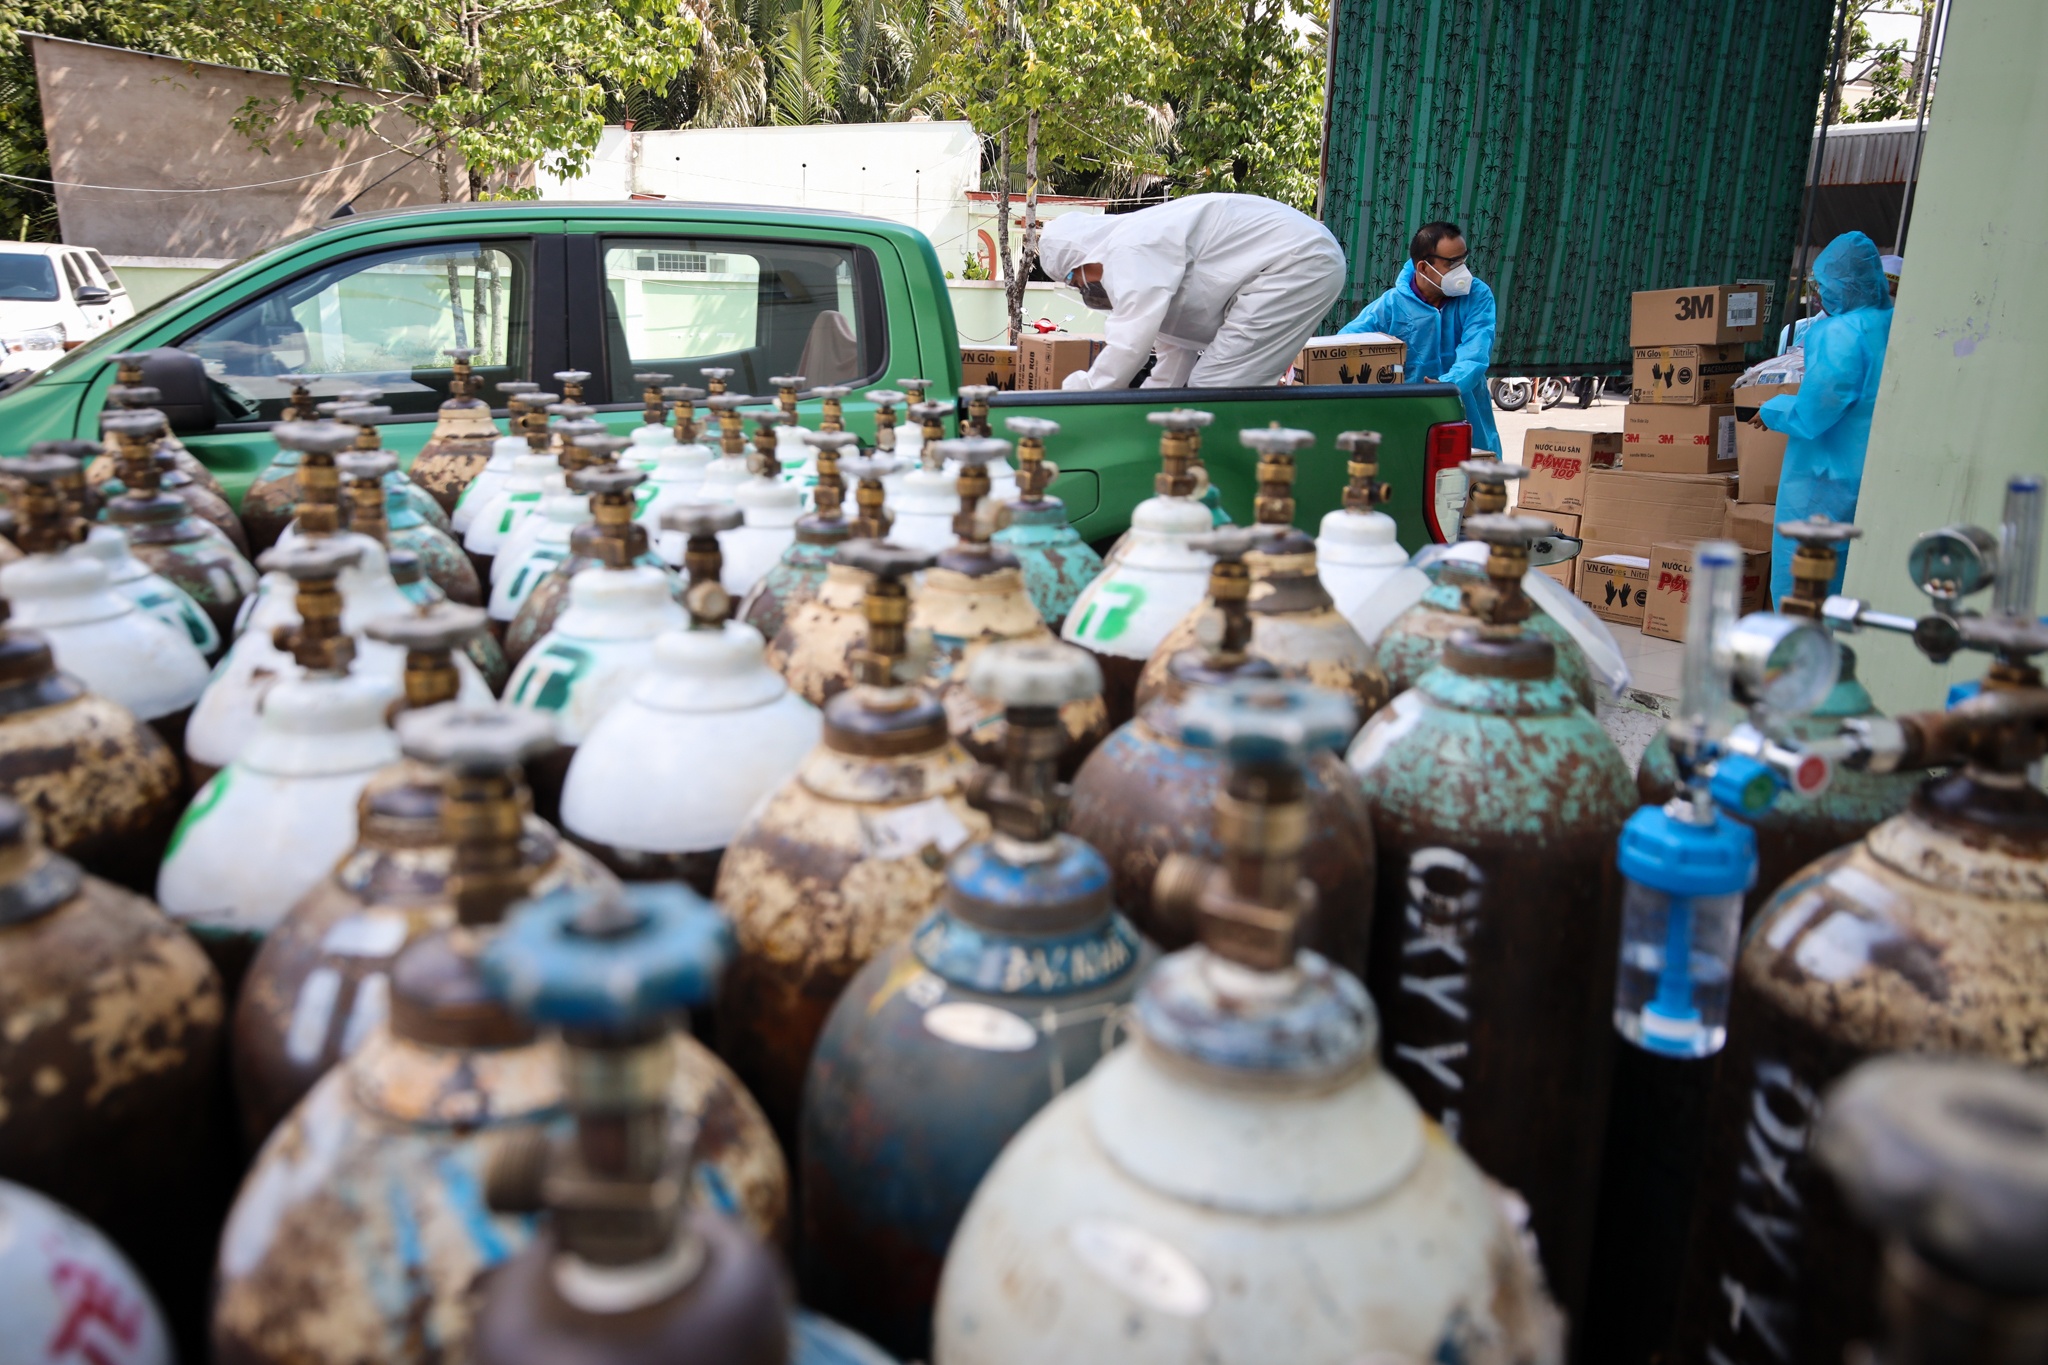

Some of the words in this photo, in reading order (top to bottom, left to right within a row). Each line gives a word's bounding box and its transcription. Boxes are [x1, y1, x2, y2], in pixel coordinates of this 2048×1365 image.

[1675, 294, 1714, 321] 3M
[961, 353, 975, 362] VN
[1312, 350, 1328, 359] VN
[1636, 350, 1646, 358] VN
[1673, 349, 1694, 357] Nitrile
[1624, 433, 1640, 443] 3M
[1658, 434, 1674, 444] 3M
[1693, 435, 1710, 445] 3M
[1534, 443, 1553, 451] NƯỚC
[1567, 445, 1581, 453] SÀN
[1531, 452, 1582, 473] POWER
[1551, 468, 1577, 480] 100
[1587, 563, 1599, 572] VN
[1600, 565, 1627, 576] Gloves
[1631, 570, 1649, 579] Nitril
[1661, 561, 1683, 571] NƯỚC
[1398, 846, 1485, 1022] OXY
